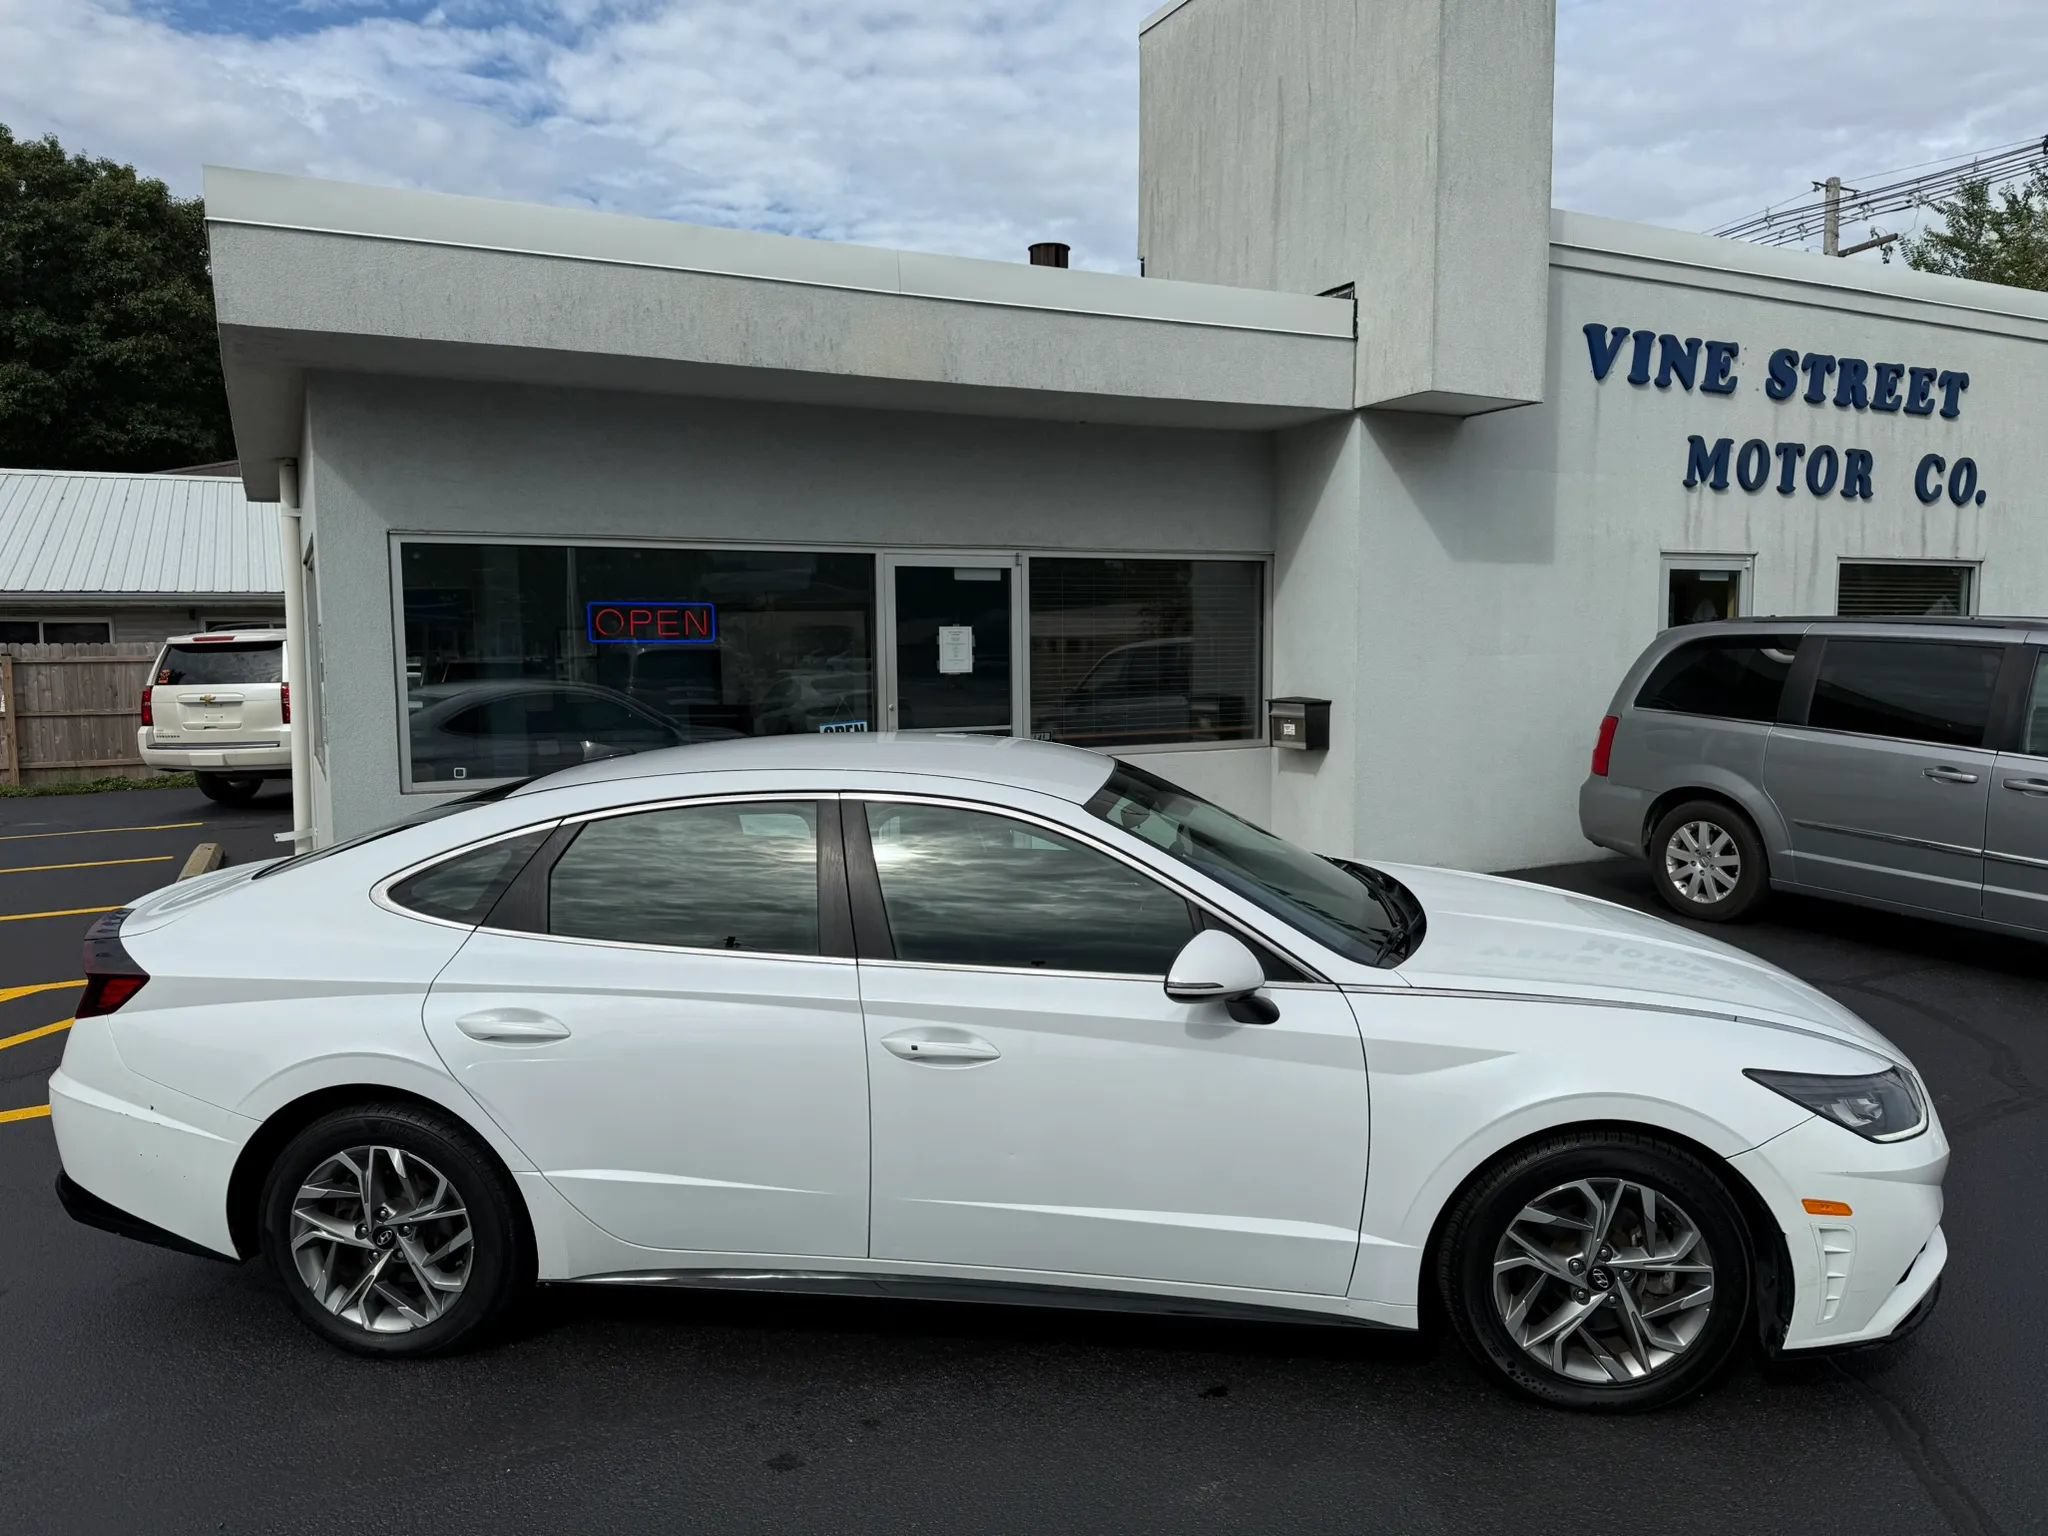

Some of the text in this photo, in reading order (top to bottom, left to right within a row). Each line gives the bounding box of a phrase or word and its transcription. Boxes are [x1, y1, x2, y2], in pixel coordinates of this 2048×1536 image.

[1583, 323, 1969, 418] VINE STREET
[1682, 434, 1986, 507] MOTOR CO.
[595, 608, 709, 637] OPEN
